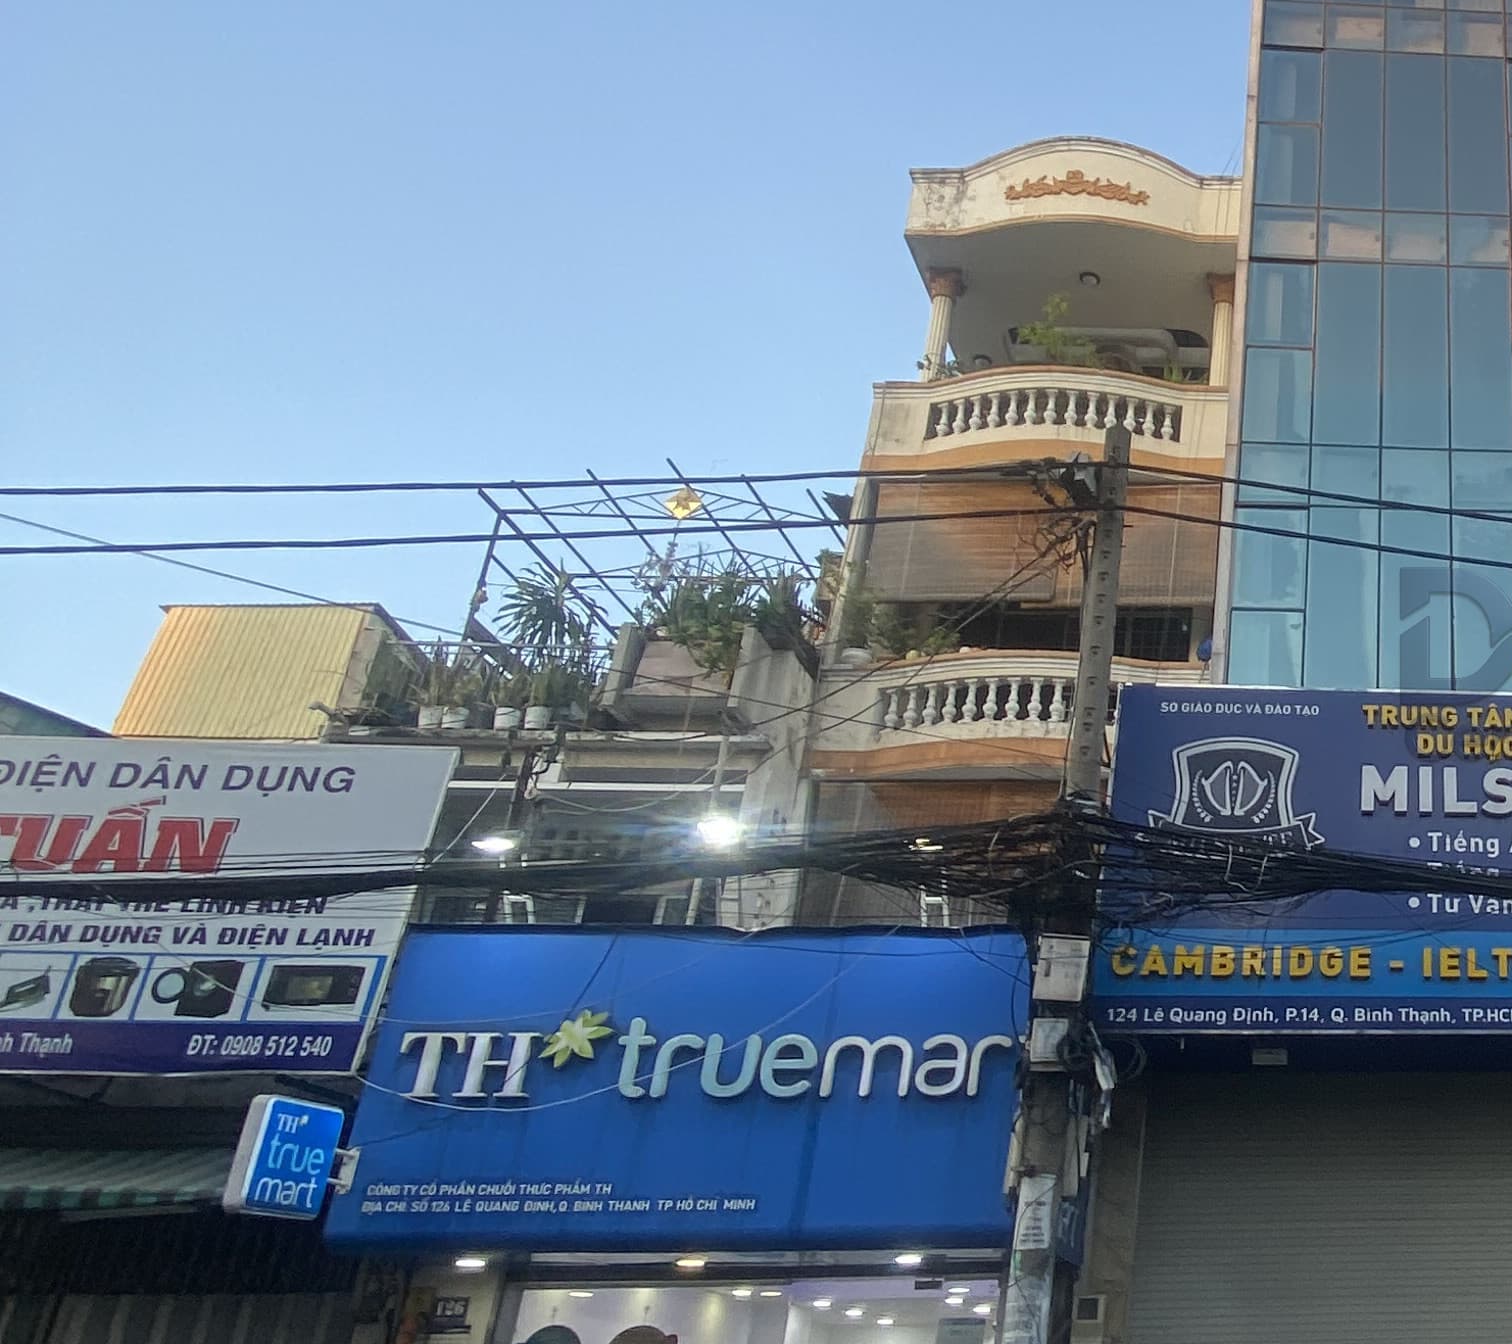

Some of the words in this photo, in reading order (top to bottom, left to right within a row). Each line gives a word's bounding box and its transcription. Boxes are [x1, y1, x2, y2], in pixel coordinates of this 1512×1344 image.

[1361, 704, 1458, 728] TRUNG
[1416, 732, 1454, 757] DU
[109, 756, 208, 790] DÂN
[221, 764, 356, 796] DỤNG
[0, 795, 240, 875] UẤN
[9, 922, 72, 943] DÂN
[80, 924, 163, 948] DỤNG
[173, 922, 208, 945] VÀ
[217, 923, 289, 950] ĐIỆN
[297, 927, 377, 950] LẠNH
[1111, 945, 1372, 979] CAMBRIDGE
[1106, 1008, 1138, 1022] 124
[1143, 1007, 1165, 1022] Lê
[1169, 1008, 1227, 1025] Quang
[1285, 1007, 1325, 1024] P.14,
[1331, 1008, 1349, 1024] Q.
[1398, 1007, 1457, 1025] Thạnh,
[19, 1032, 73, 1058] Thạnh
[221, 1035, 261, 1056] 0908
[265, 1036, 297, 1057] 512
[300, 1036, 333, 1057] 540
[400, 1031, 543, 1099] TH
[277, 1112, 301, 1134] TH
[267, 1133, 325, 1175] true
[254, 1176, 318, 1208] mart
[403, 1184, 419, 1196] TY
[595, 1183, 613, 1195] TH
[431, 1200, 450, 1212] 126
[454, 1199, 472, 1213] LÊ
[475, 1200, 520, 1213] QUANG
[658, 1199, 673, 1211] TP
[723, 1199, 756, 1211] MINH
